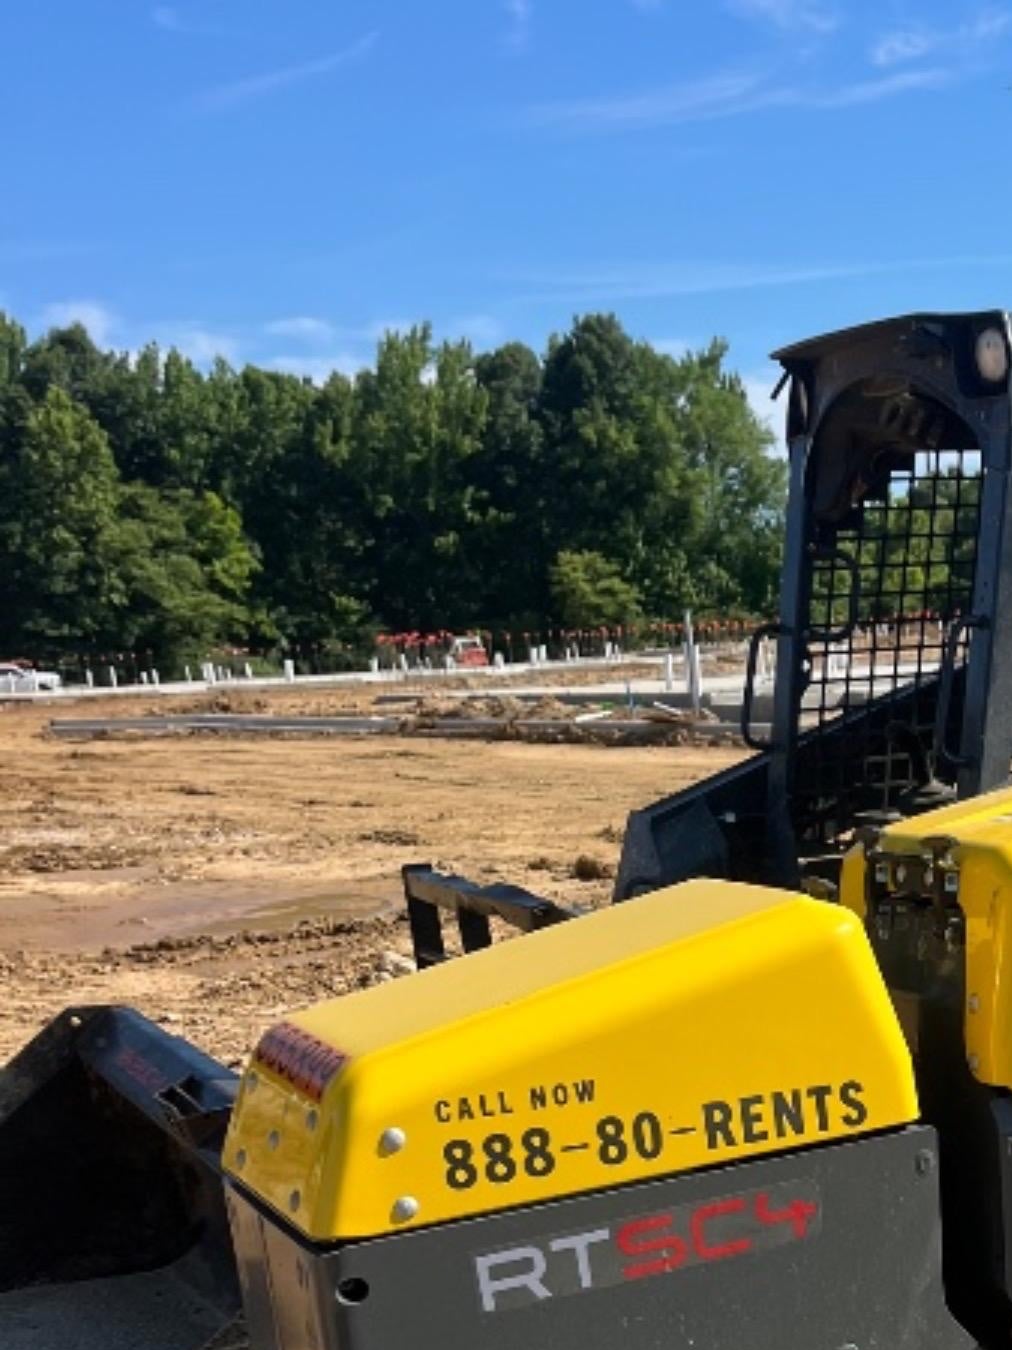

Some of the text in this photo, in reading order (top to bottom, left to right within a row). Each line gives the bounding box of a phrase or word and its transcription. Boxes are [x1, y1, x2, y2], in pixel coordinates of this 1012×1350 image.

[434, 1079, 596, 1123] CALL NOW
[442, 1081, 868, 1191] 888-80-RENTS
